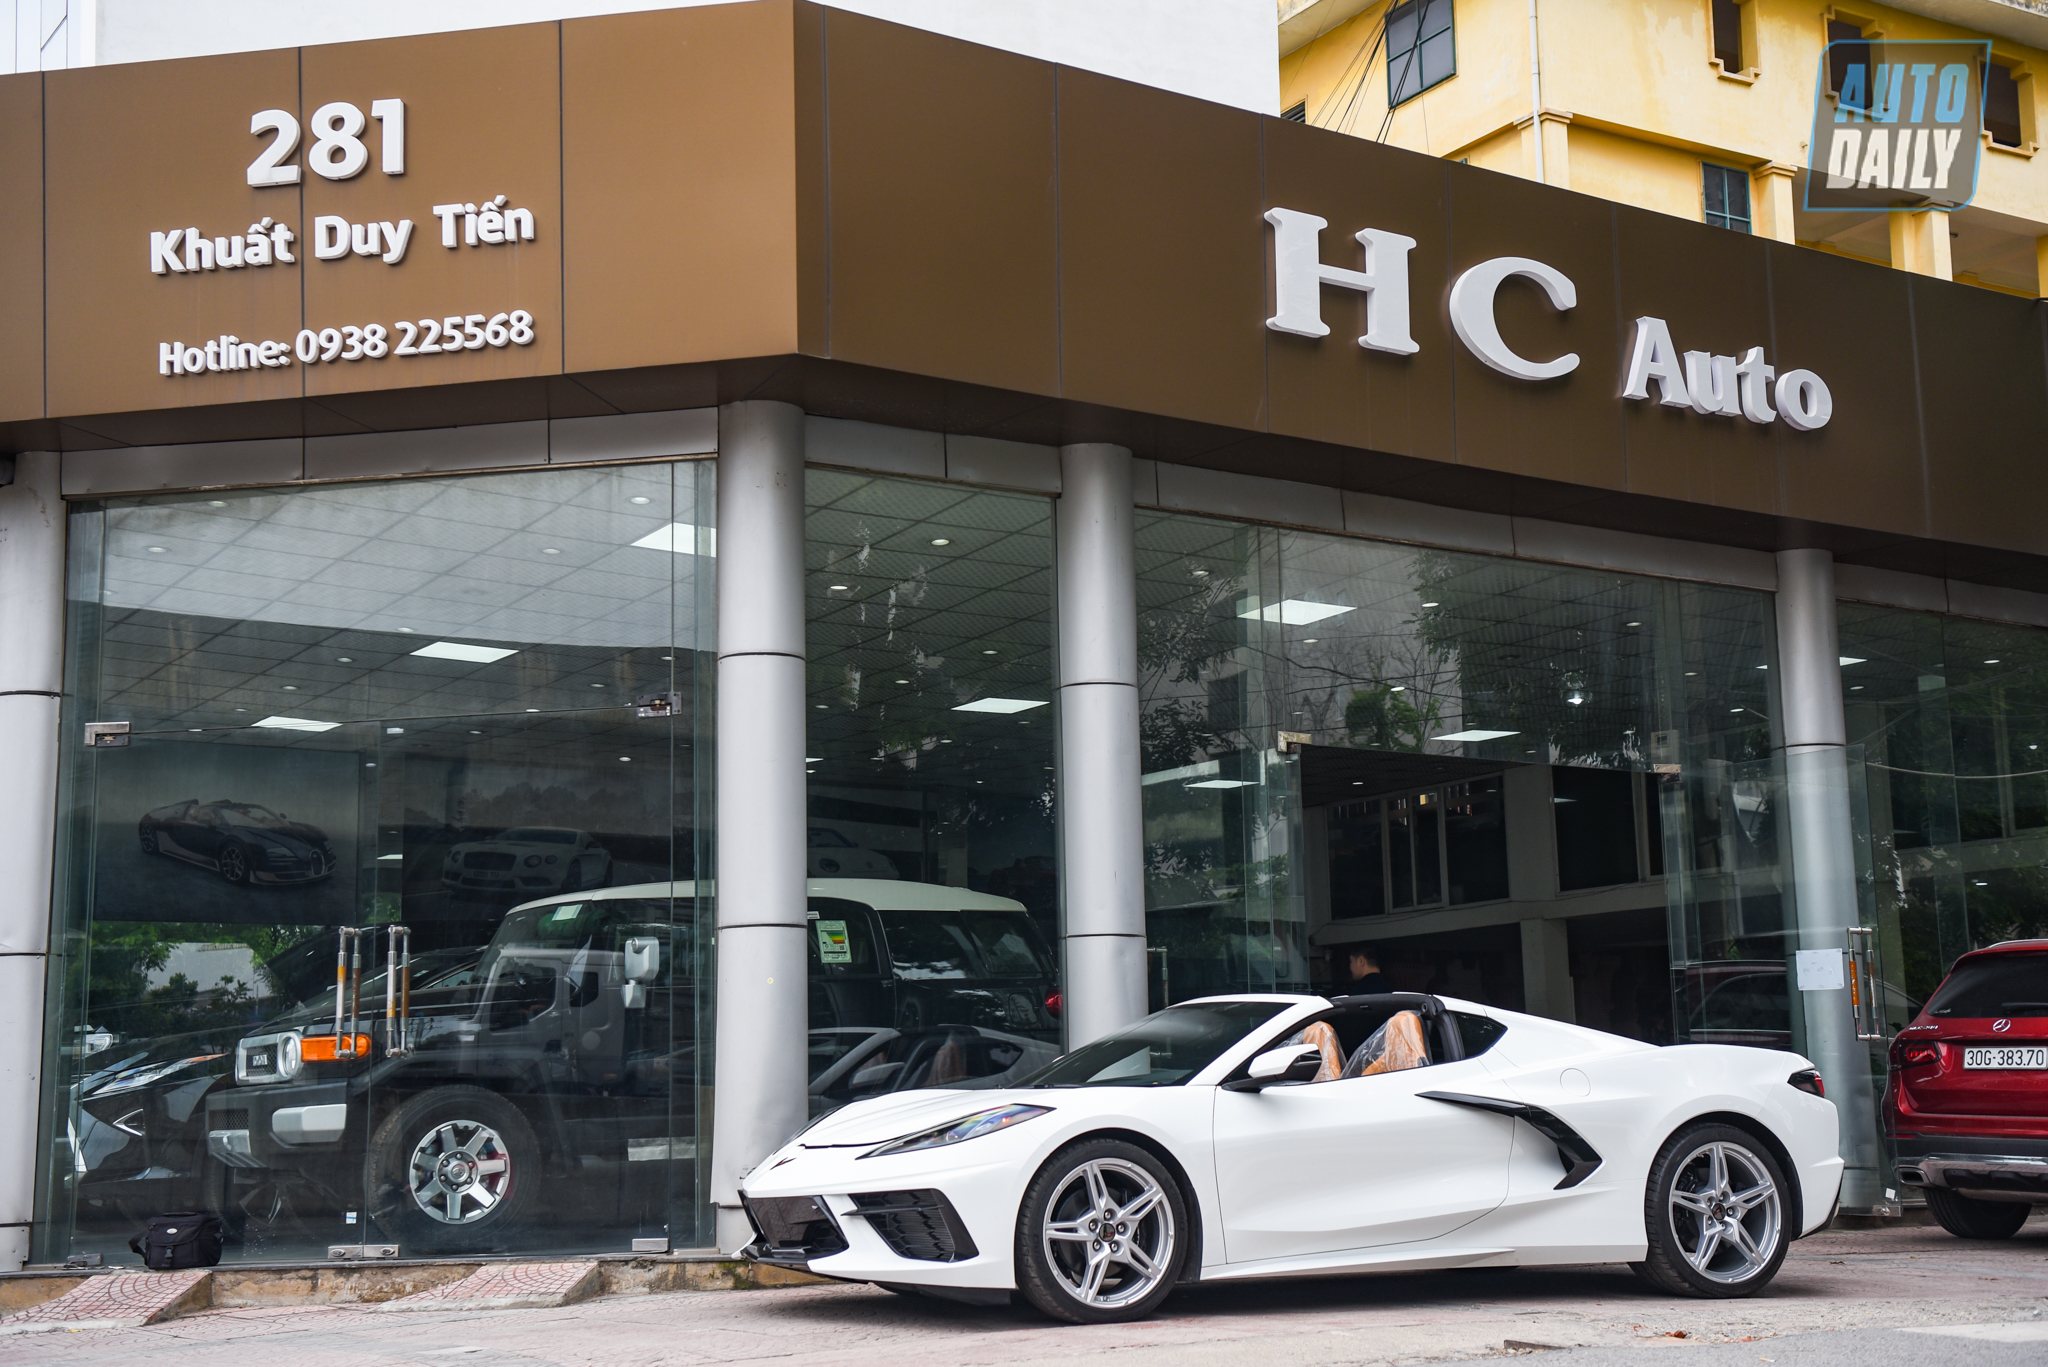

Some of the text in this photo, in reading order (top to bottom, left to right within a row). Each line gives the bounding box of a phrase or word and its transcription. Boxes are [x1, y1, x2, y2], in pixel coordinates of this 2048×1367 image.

[247, 98, 405, 188] 281
[150, 194, 535, 275] Khuất Duy Tiến
[159, 309, 535, 376] Hotline: 0938 225568
[1622, 315, 1833, 432] Auto
[1966, 1049, 2045, 1067] 30G-383.70
